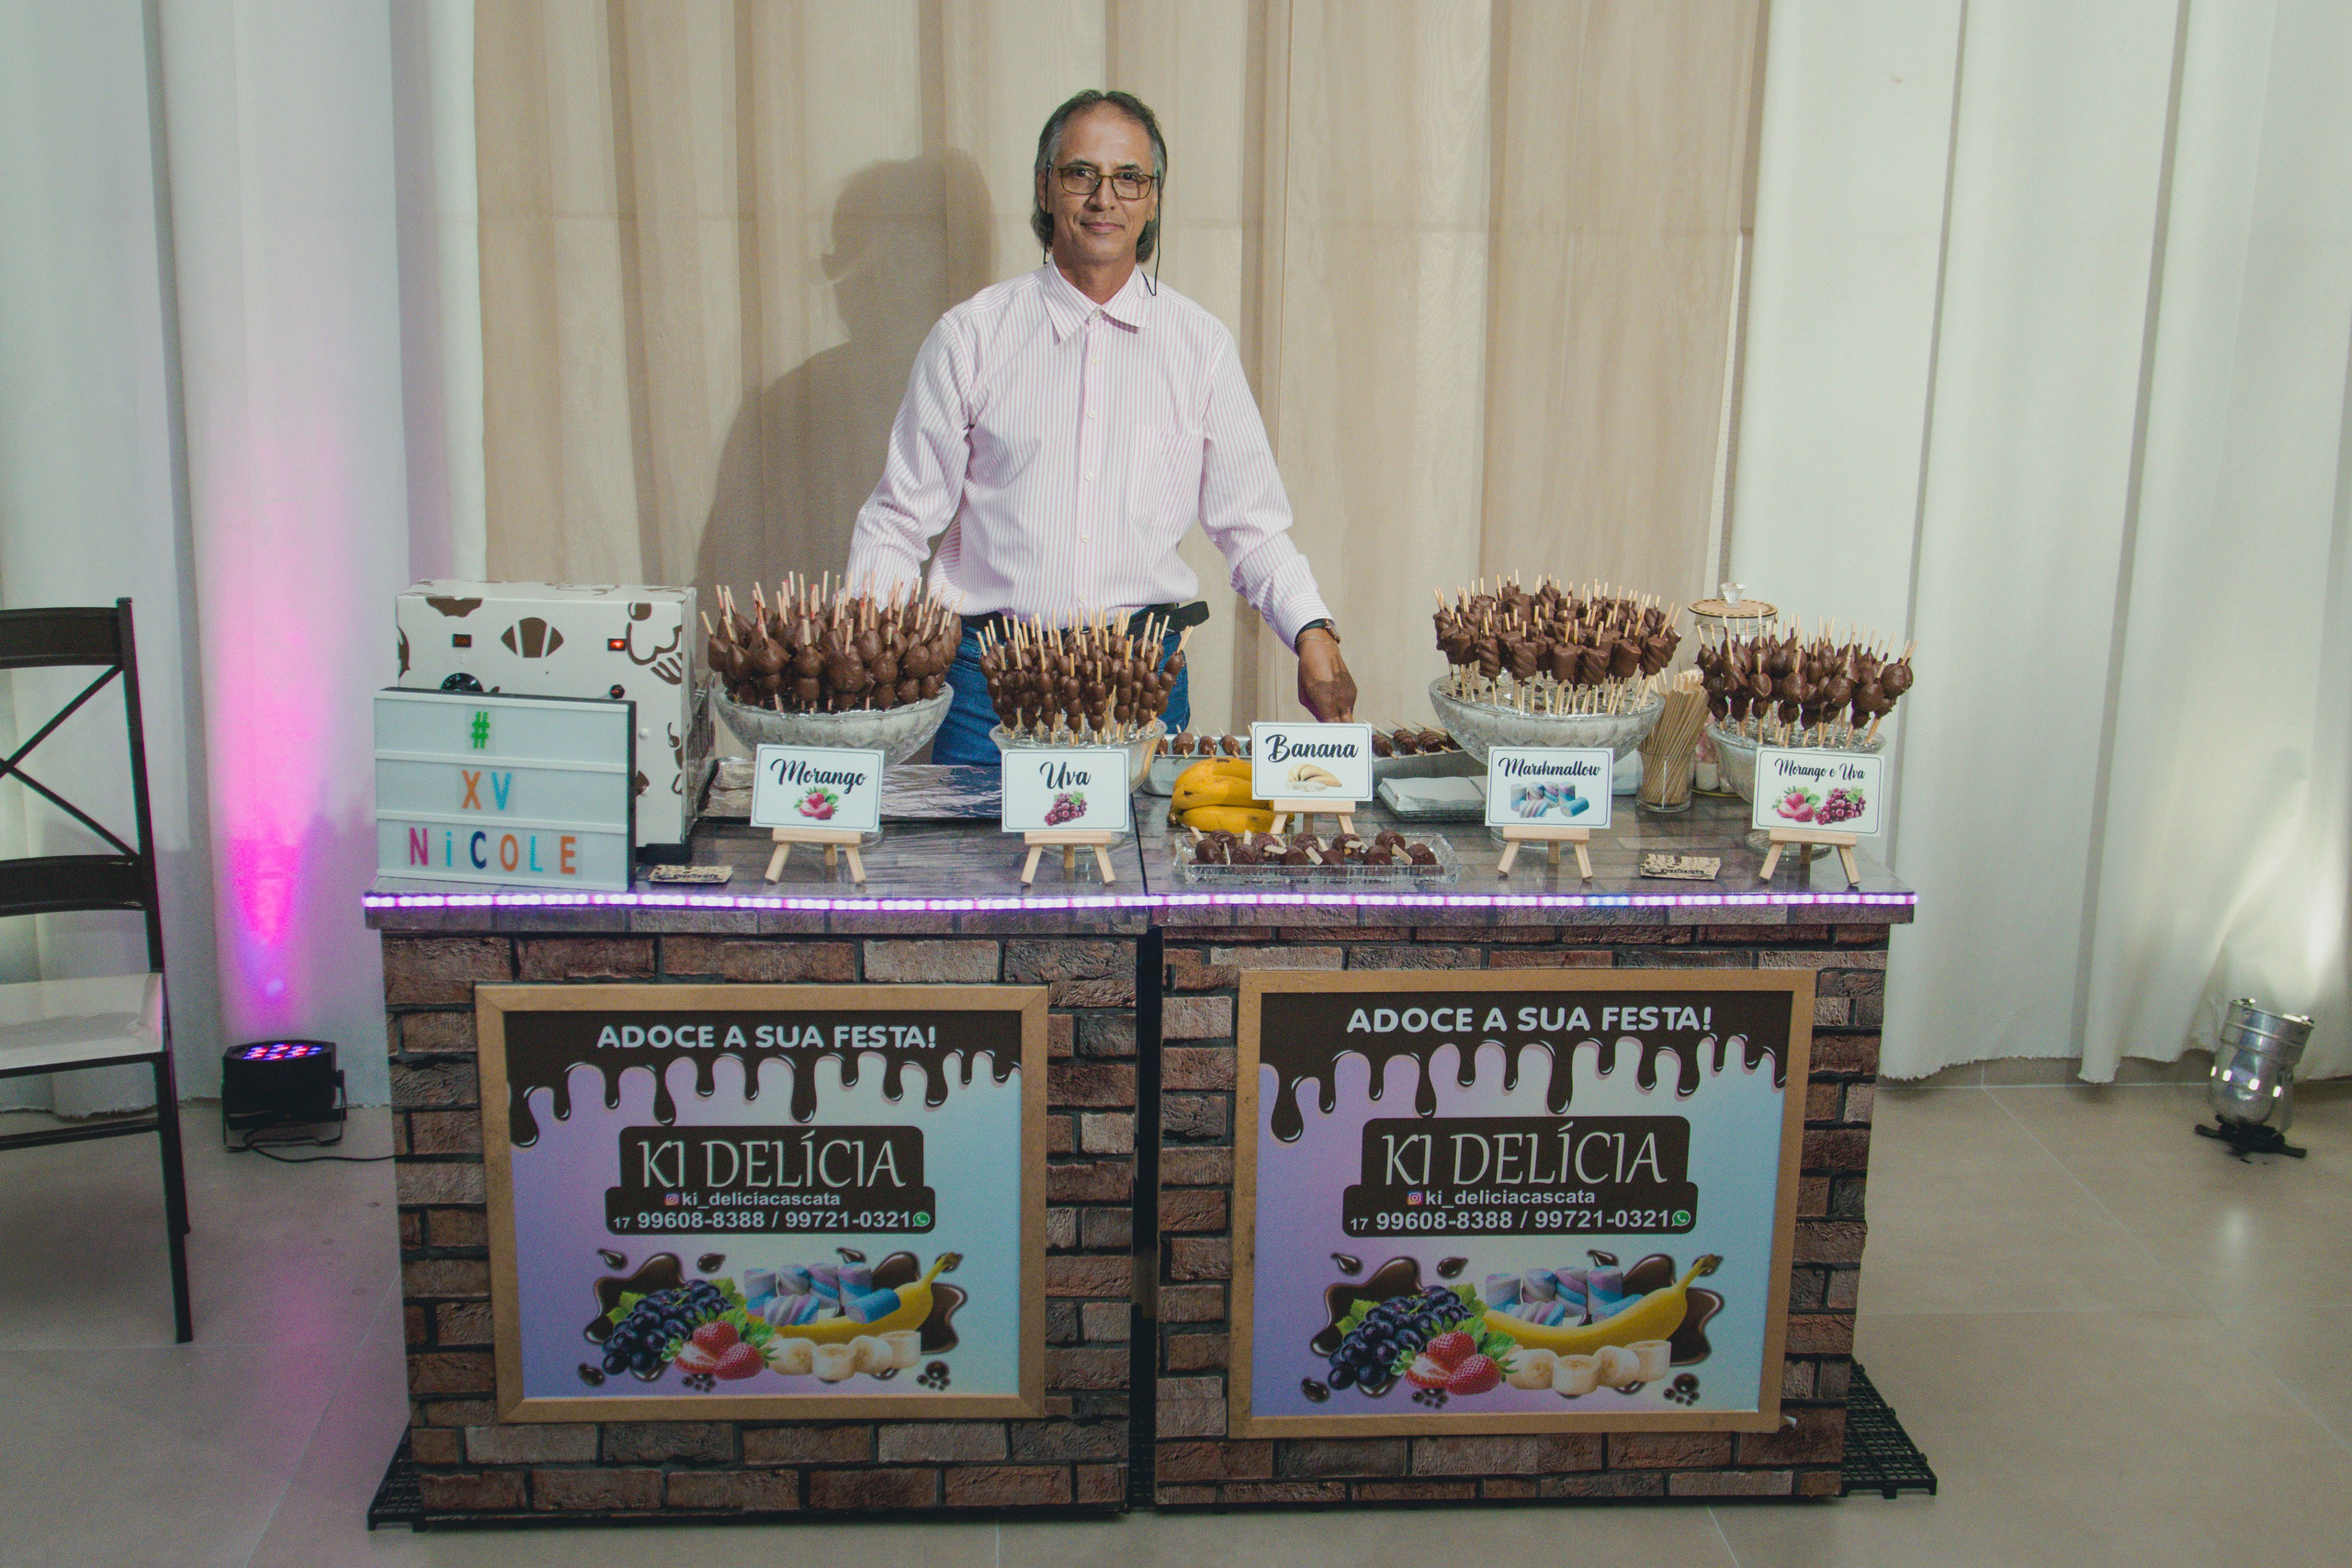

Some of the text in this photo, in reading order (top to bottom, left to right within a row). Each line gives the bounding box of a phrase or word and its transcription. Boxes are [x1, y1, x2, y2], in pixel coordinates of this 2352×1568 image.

[1264, 734, 1359, 763] Banana
[769, 757, 867, 795] Morango
[1039, 761, 1091, 790] Uva
[1498, 757, 1602, 778] Marshmallow
[1774, 759, 1865, 782] Morango e Uva
[461, 770, 513, 810] XV
[1346, 1007, 1713, 1033] ADOCE A SUA FESTA!
[596, 1025, 936, 1049] ADOCE A SUA FESTA!
[637, 1130, 907, 1189] KI DELÍCIA
[1382, 1121, 1668, 1187] KI DELÍCIA
[682, 1192, 841, 1210] ki_deliciacascata
[1425, 1189, 1596, 1209] ki_deliciacascata
[614, 1211, 910, 1230] 17 99608-8388 / 99721-0321
[1350, 1210, 1669, 1231] 17 99608-8388 / 99721-0321
